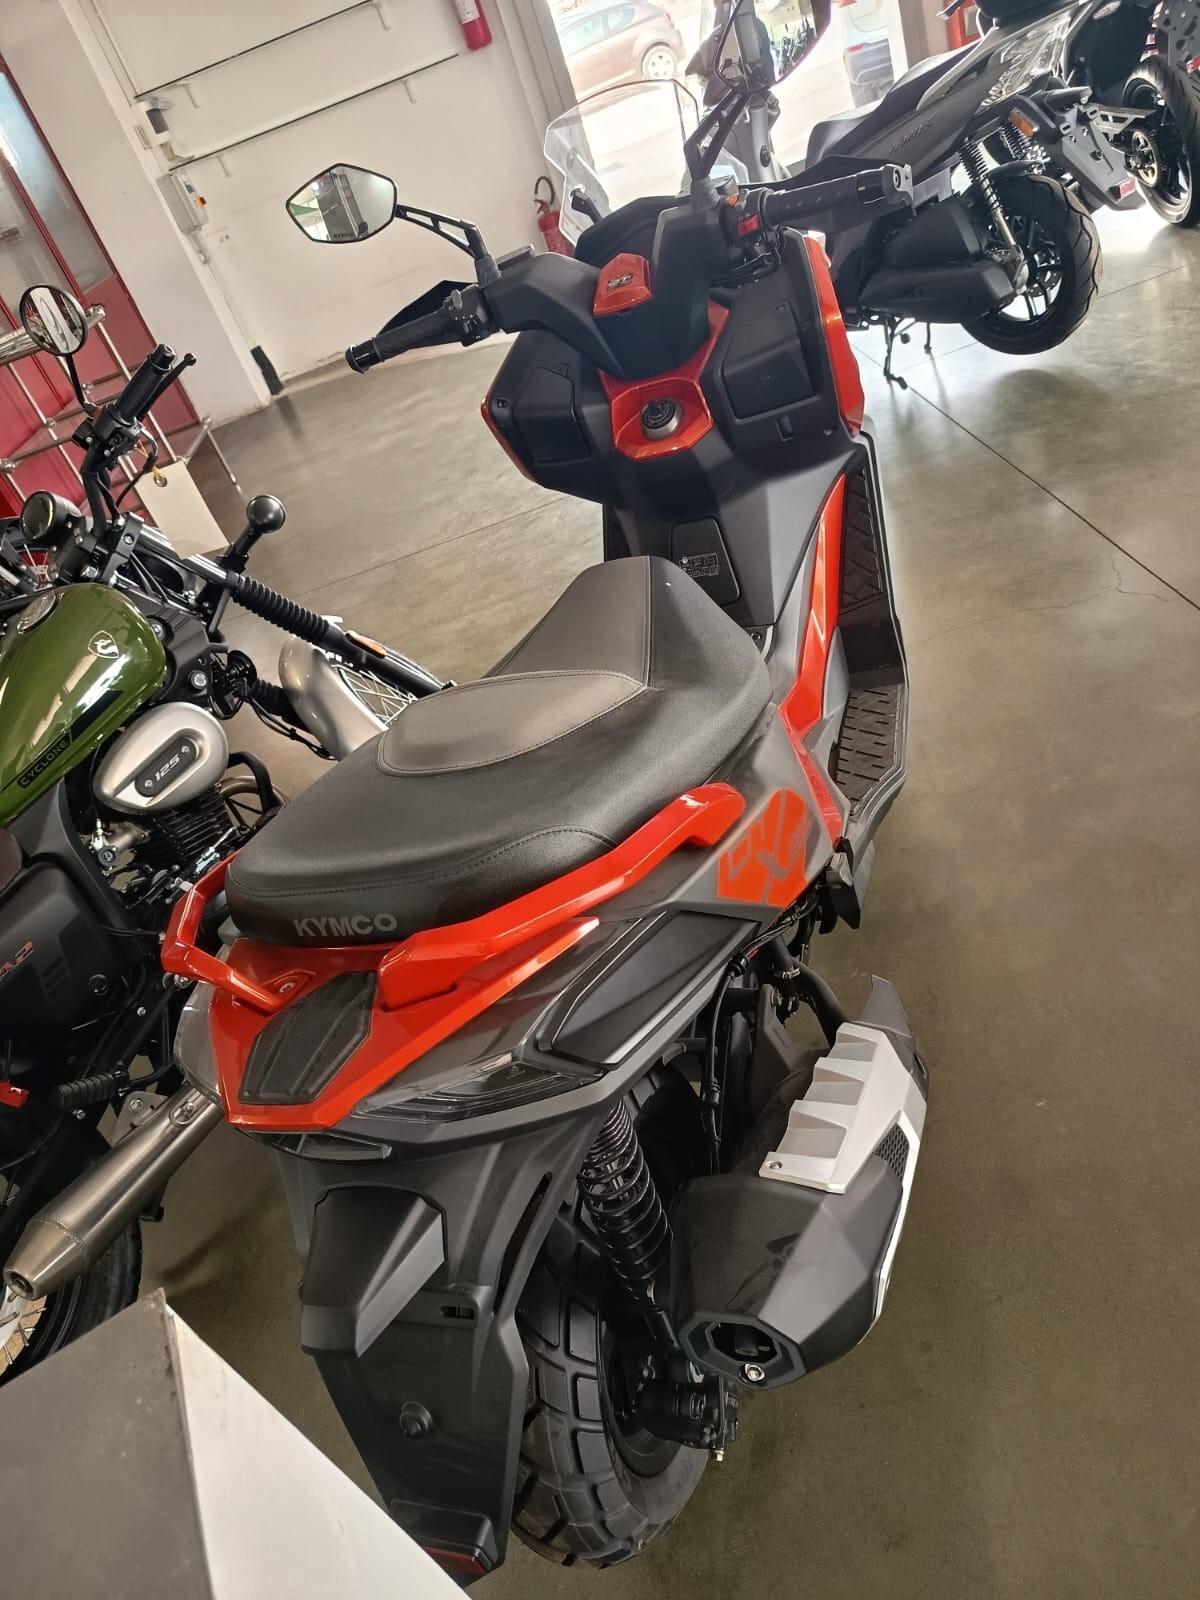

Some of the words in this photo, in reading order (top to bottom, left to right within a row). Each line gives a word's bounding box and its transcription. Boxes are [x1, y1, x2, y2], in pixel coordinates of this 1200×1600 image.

[20, 740, 68, 786] CYCLONE
[155, 753, 180, 781] 125
[293, 913, 398, 937] KYMCO
